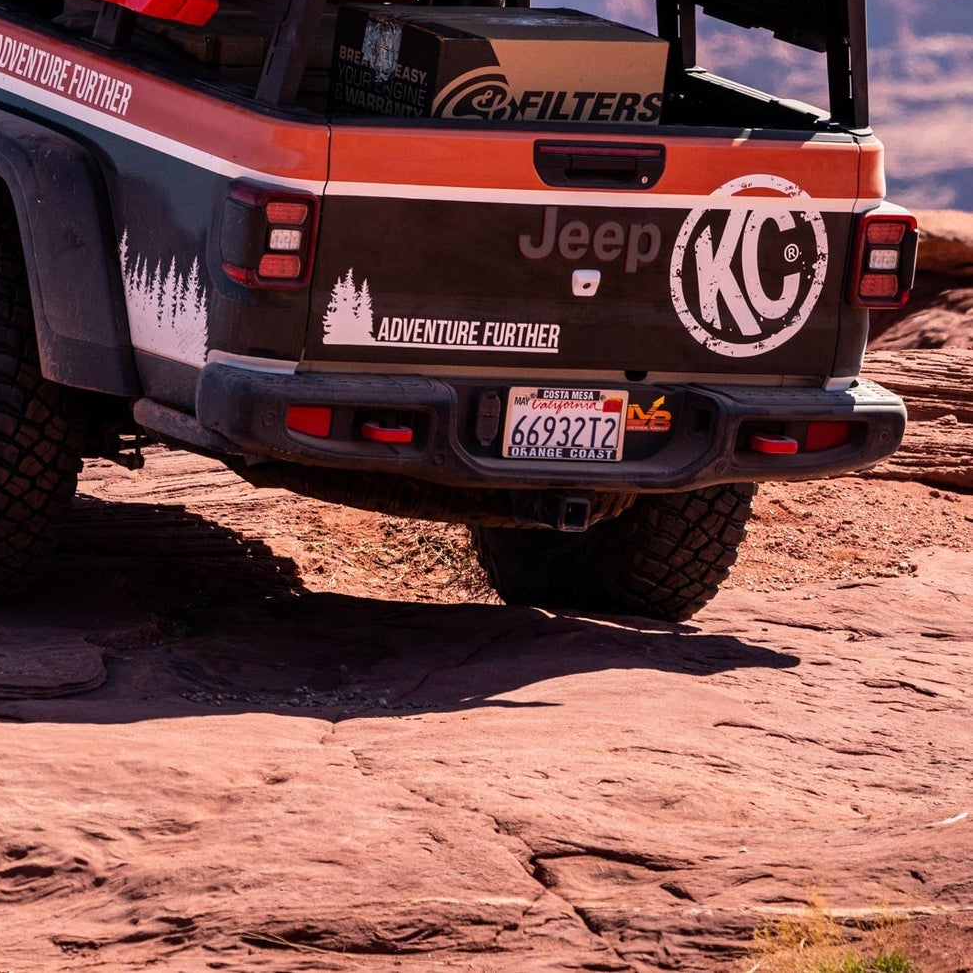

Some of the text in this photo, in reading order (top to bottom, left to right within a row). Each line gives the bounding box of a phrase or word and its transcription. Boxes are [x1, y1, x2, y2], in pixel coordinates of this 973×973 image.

[68, 63, 132, 116] FURTHER
[338, 61, 372, 90] YOUR
[394, 63, 428, 86] EASY.
[345, 85, 423, 117] WARRANTY
[518, 90, 663, 123] FILTERS
[518, 205, 662, 273] Jeep
[693, 207, 801, 336] KC
[377, 316, 561, 348] ADVENTURE FURTHER
[514, 397, 530, 406] MAY
[532, 399, 603, 415] California
[543, 389, 594, 401] COSTA MESA
[511, 415, 616, 449] 66932T2
[511, 447, 614, 460] ORANGE COAST
